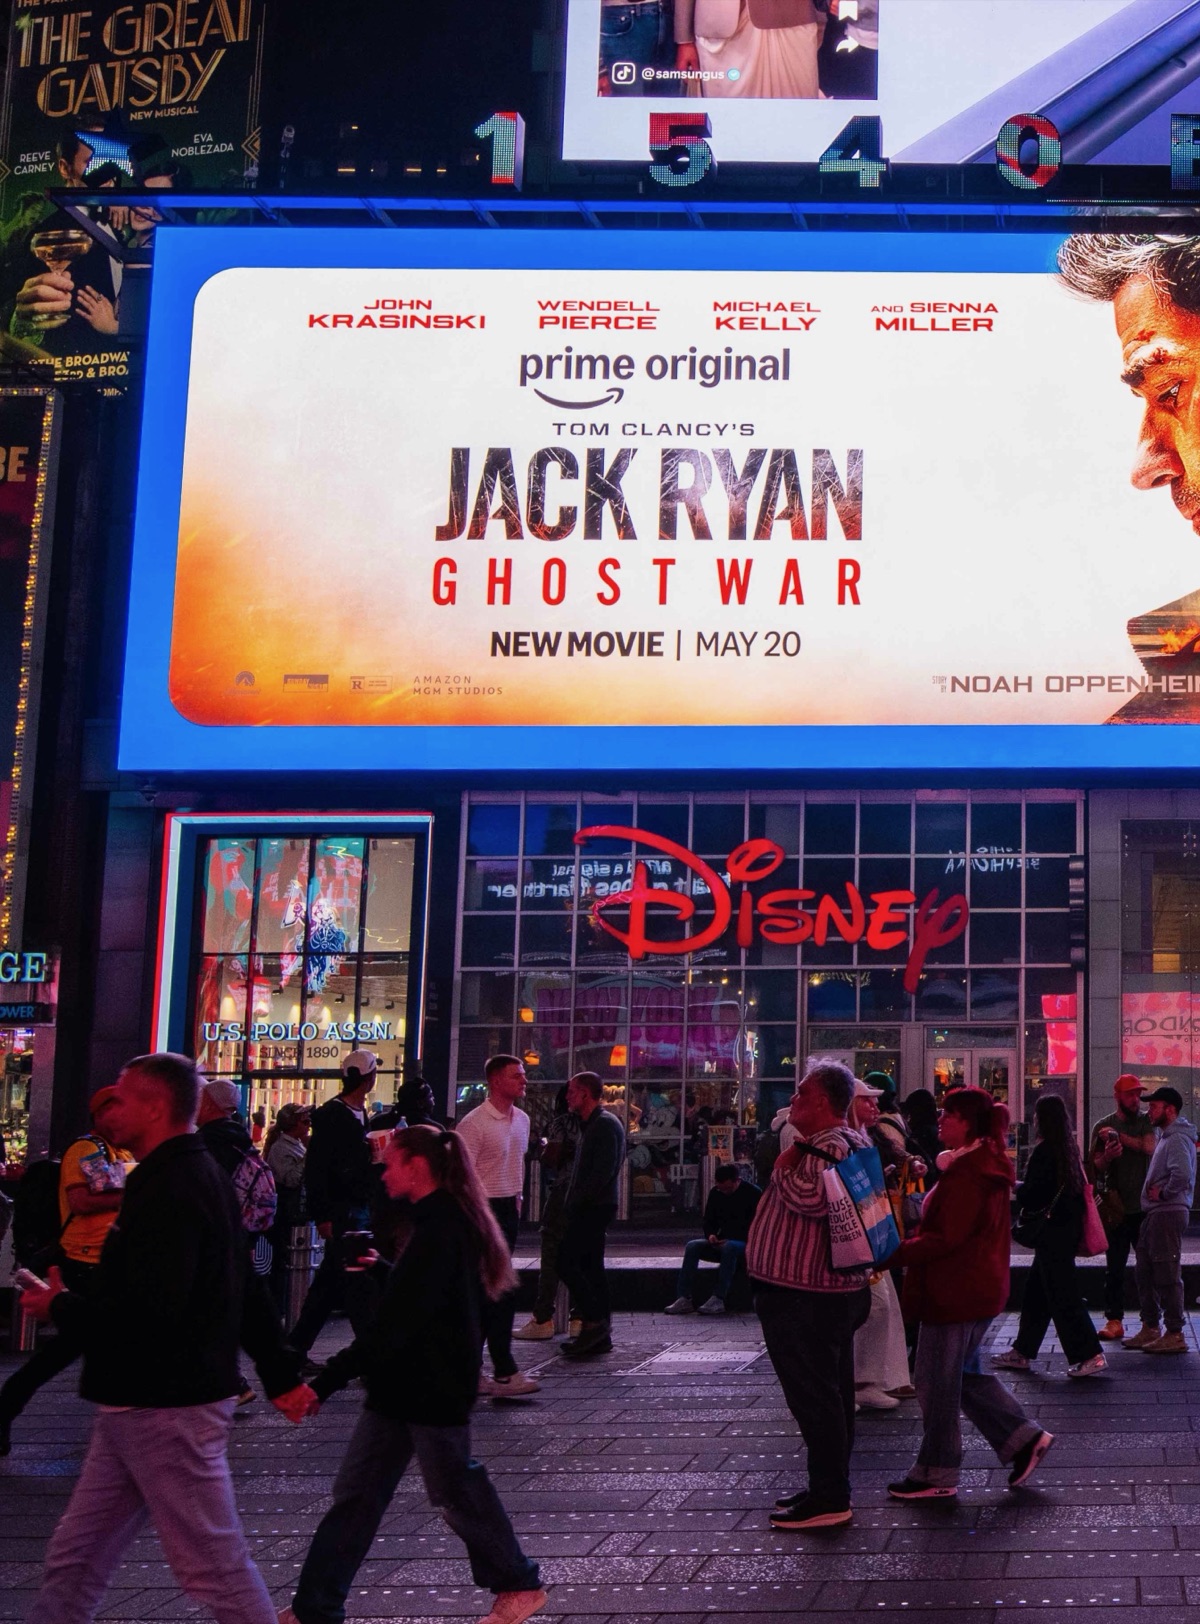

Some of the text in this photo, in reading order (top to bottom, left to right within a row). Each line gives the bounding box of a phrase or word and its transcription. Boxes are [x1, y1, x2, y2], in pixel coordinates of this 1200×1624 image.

[16, 11, 92, 67] THE
[641, 67, 725, 82] @samsungus
[36, 49, 227, 118] GATSBY
[130, 107, 199, 121] NEW MUSICAL
[193, 133, 213, 144] EVA
[20, 151, 51, 163] REEVE
[171, 142, 234, 158] NOBLEZADA
[14, 162, 55, 176] CARNEY
[364, 299, 999, 314] JOHN WENDELL MICHAEL AND SIENNA
[308, 314, 994, 332] KRASINSKI PIERCE KELLY MILLER
[65, 351, 131, 368] BROADWA
[519, 345, 791, 389] prime original
[99, 364, 129, 378] BRO
[552, 423, 756, 437] TOM CLANCY'S
[434, 446, 865, 542] JACK RYAN
[432, 556, 862, 607] GHOST WAR
[491, 630, 562, 658] NEW
[567, 630, 664, 658] MOVIE
[696, 630, 758, 658] MAY
[764, 630, 801, 658] 20
[413, 675, 471, 684] AMAZON
[932, 675, 948, 685] STORY
[951, 675, 1033, 693] NOAH
[413, 687, 503, 695] MGM STUDIOS
[0, 952, 47, 983] GE
[204, 1021, 396, 1042] U.S. POLO ASSN.
[260, 1046, 339, 1059] SINCE 1890
[839, 1229, 862, 1244] GREEN
